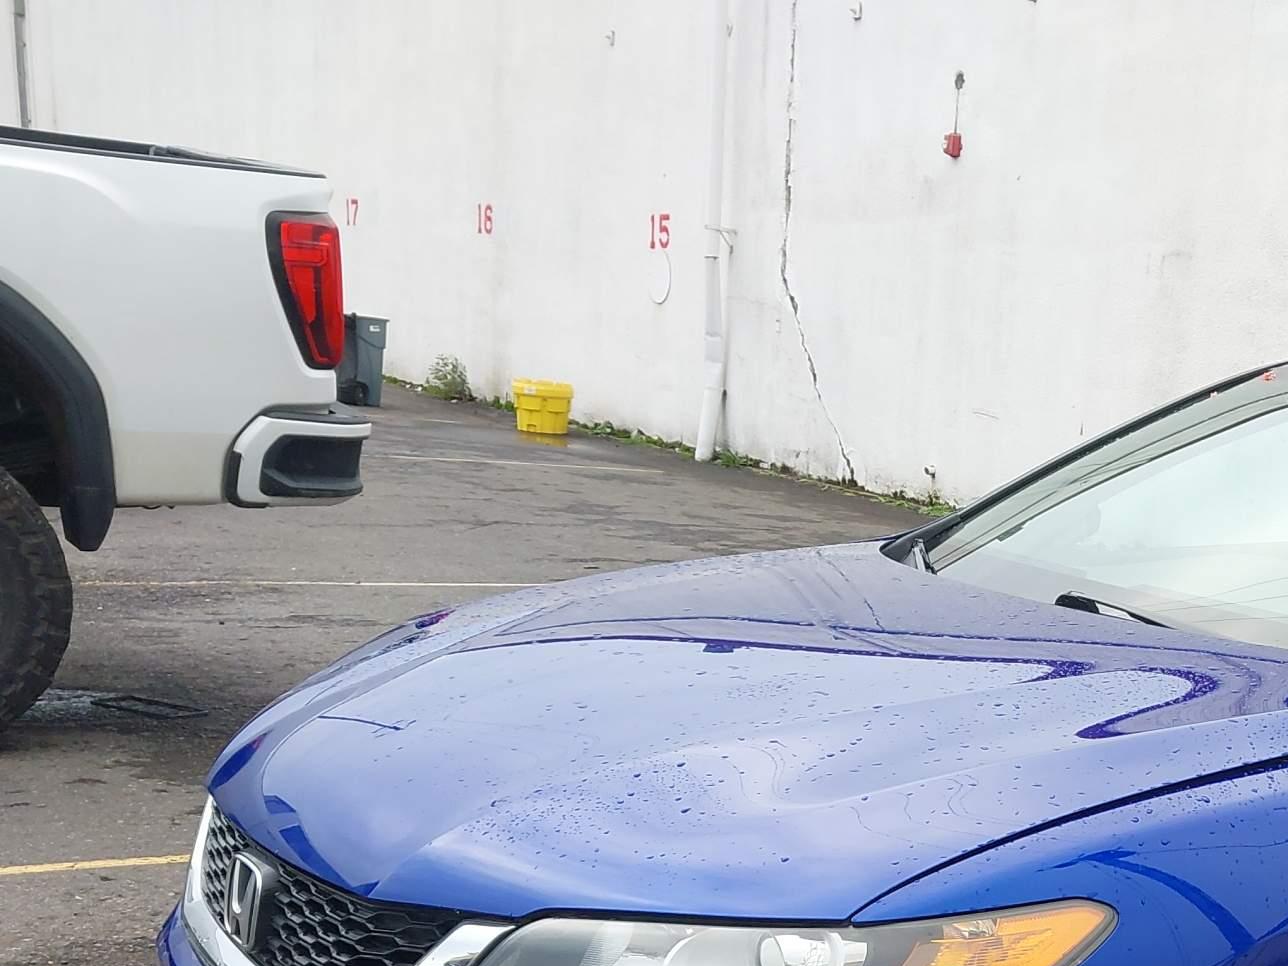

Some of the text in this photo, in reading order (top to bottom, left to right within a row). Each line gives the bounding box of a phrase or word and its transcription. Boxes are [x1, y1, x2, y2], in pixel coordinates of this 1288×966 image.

[346, 199, 359, 226] 17
[478, 203, 493, 234] 16
[650, 214, 670, 249] 15
